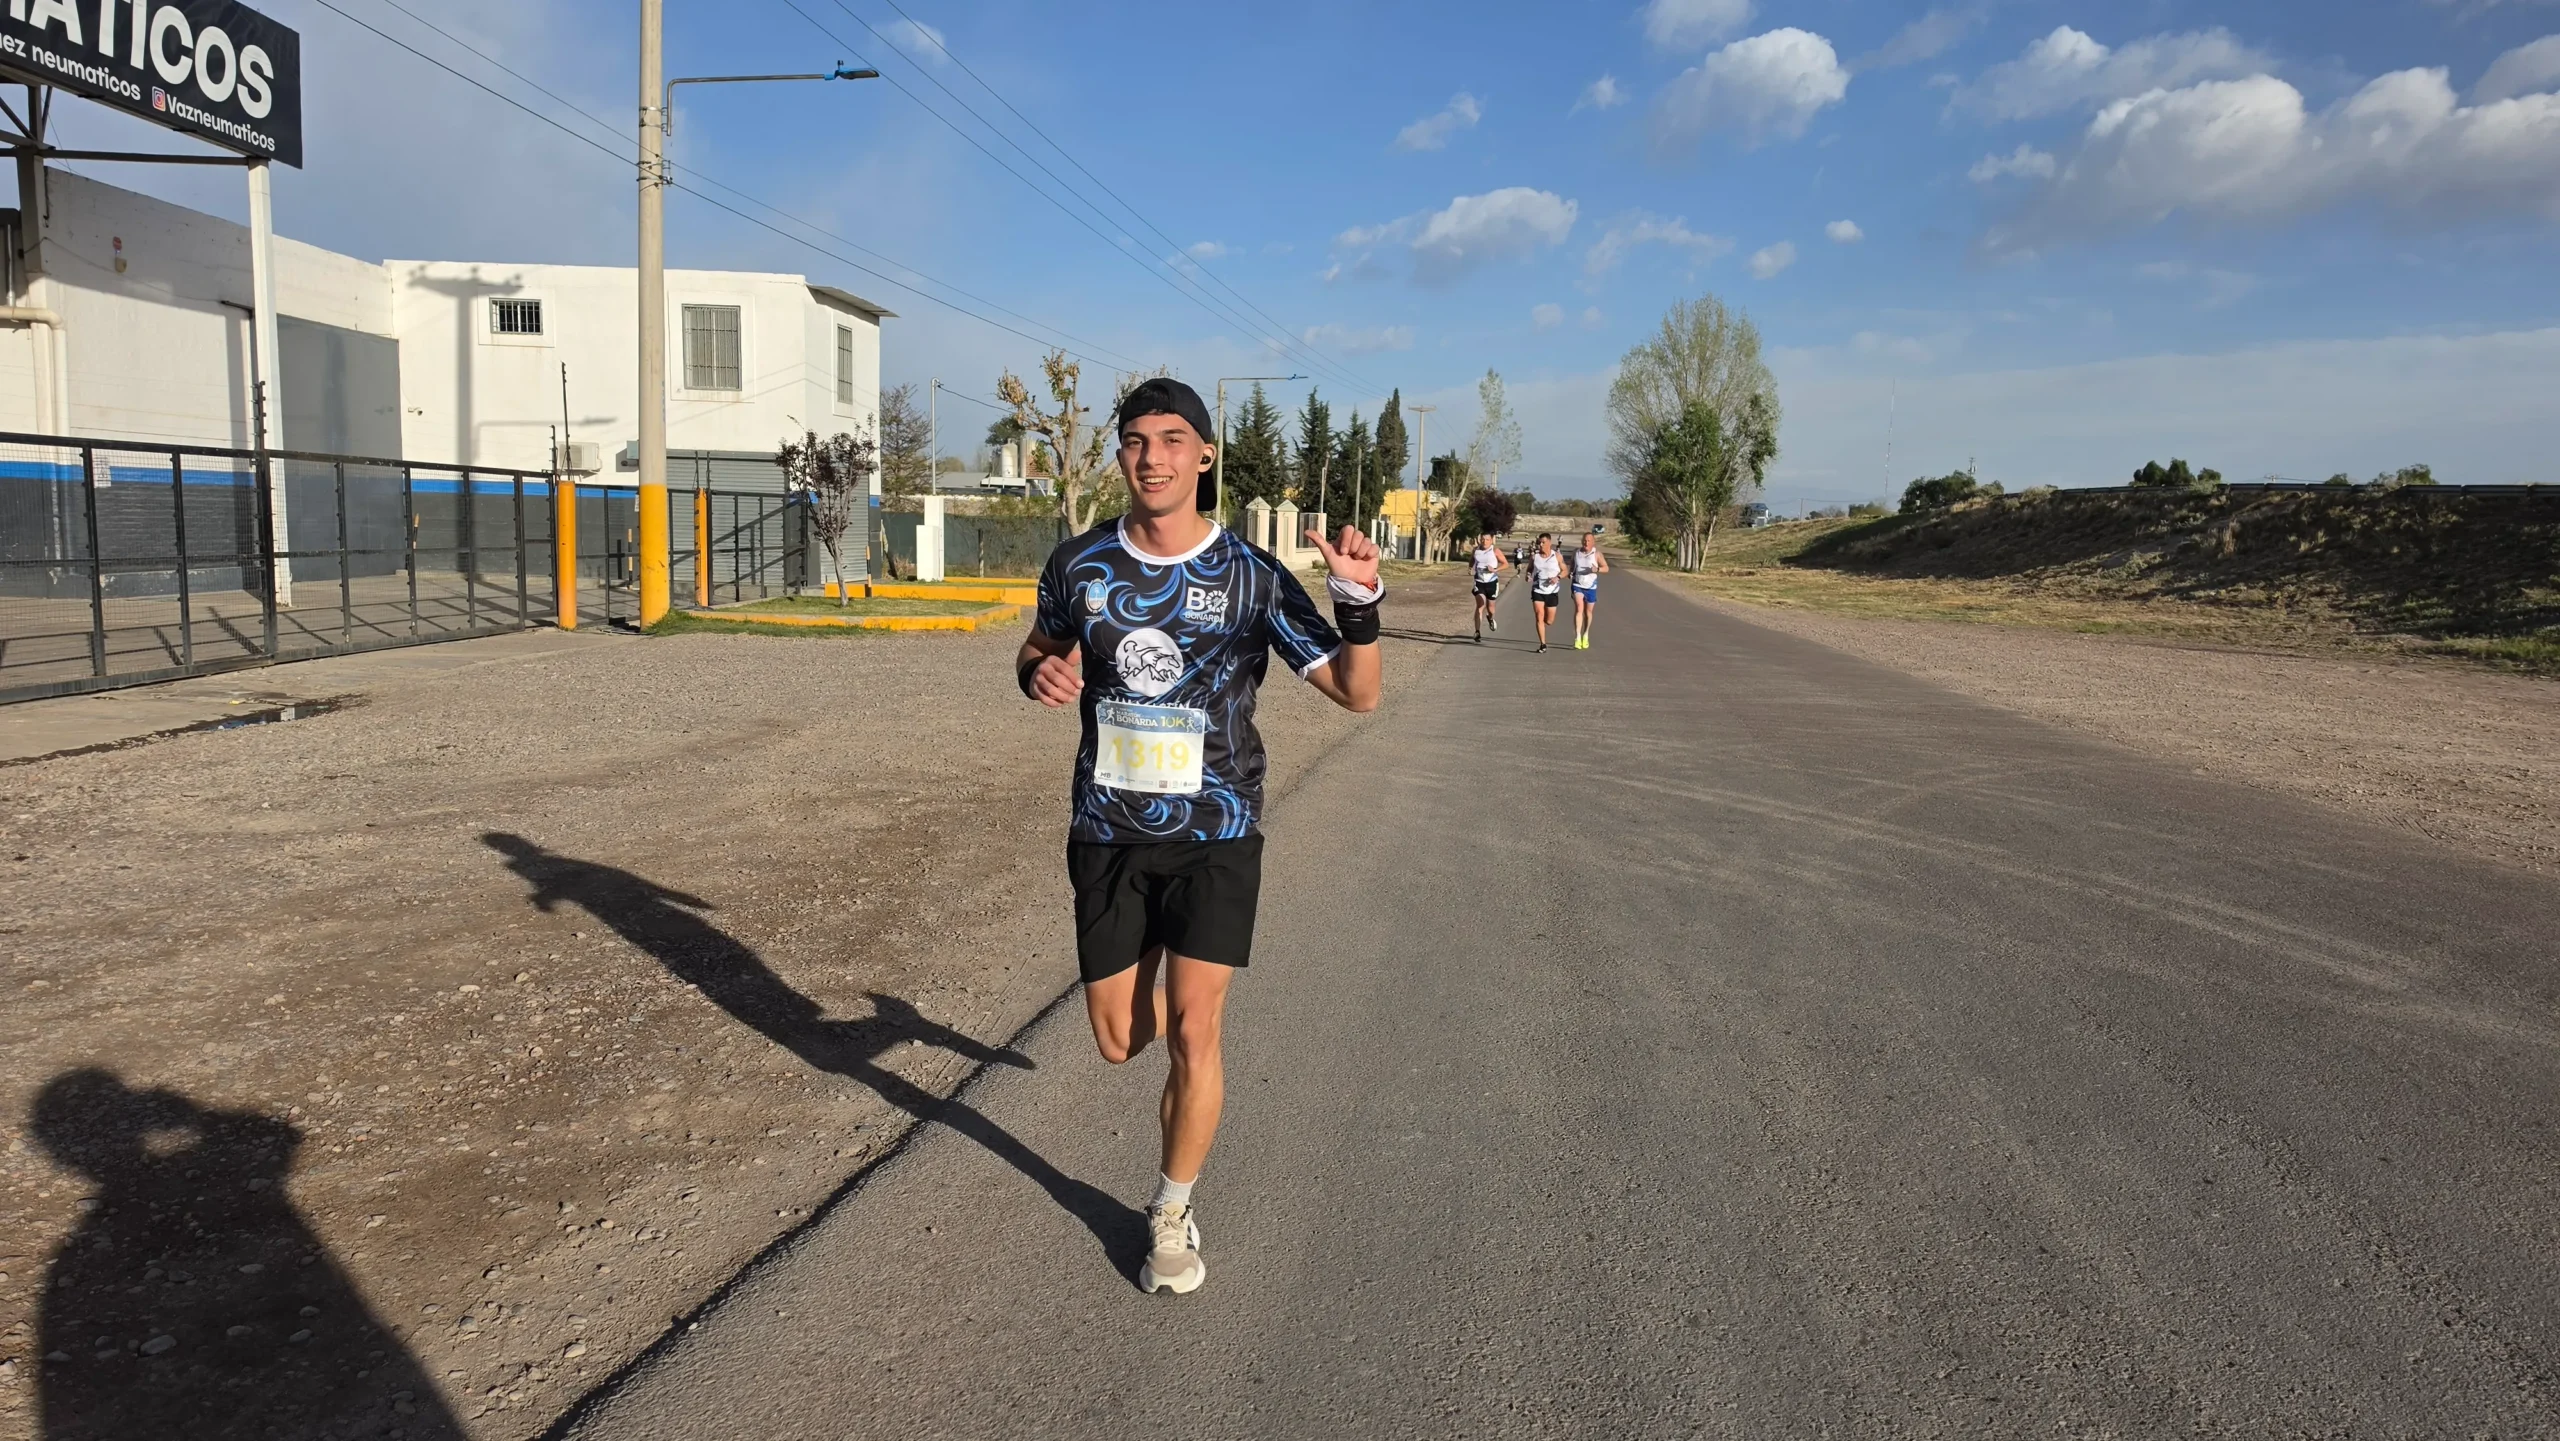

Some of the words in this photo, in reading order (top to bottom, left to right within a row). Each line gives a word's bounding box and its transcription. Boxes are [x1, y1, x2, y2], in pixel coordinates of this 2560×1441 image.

[0, 0, 274, 119] ATICOS
[32, 45, 141, 101] neumaticos
[167, 94, 275, 152] Vazneumaticos
[1112, 736, 1189, 770] 1319
[1116, 714, 1158, 727] BONARDA
[1160, 716, 1186, 728] 10K
